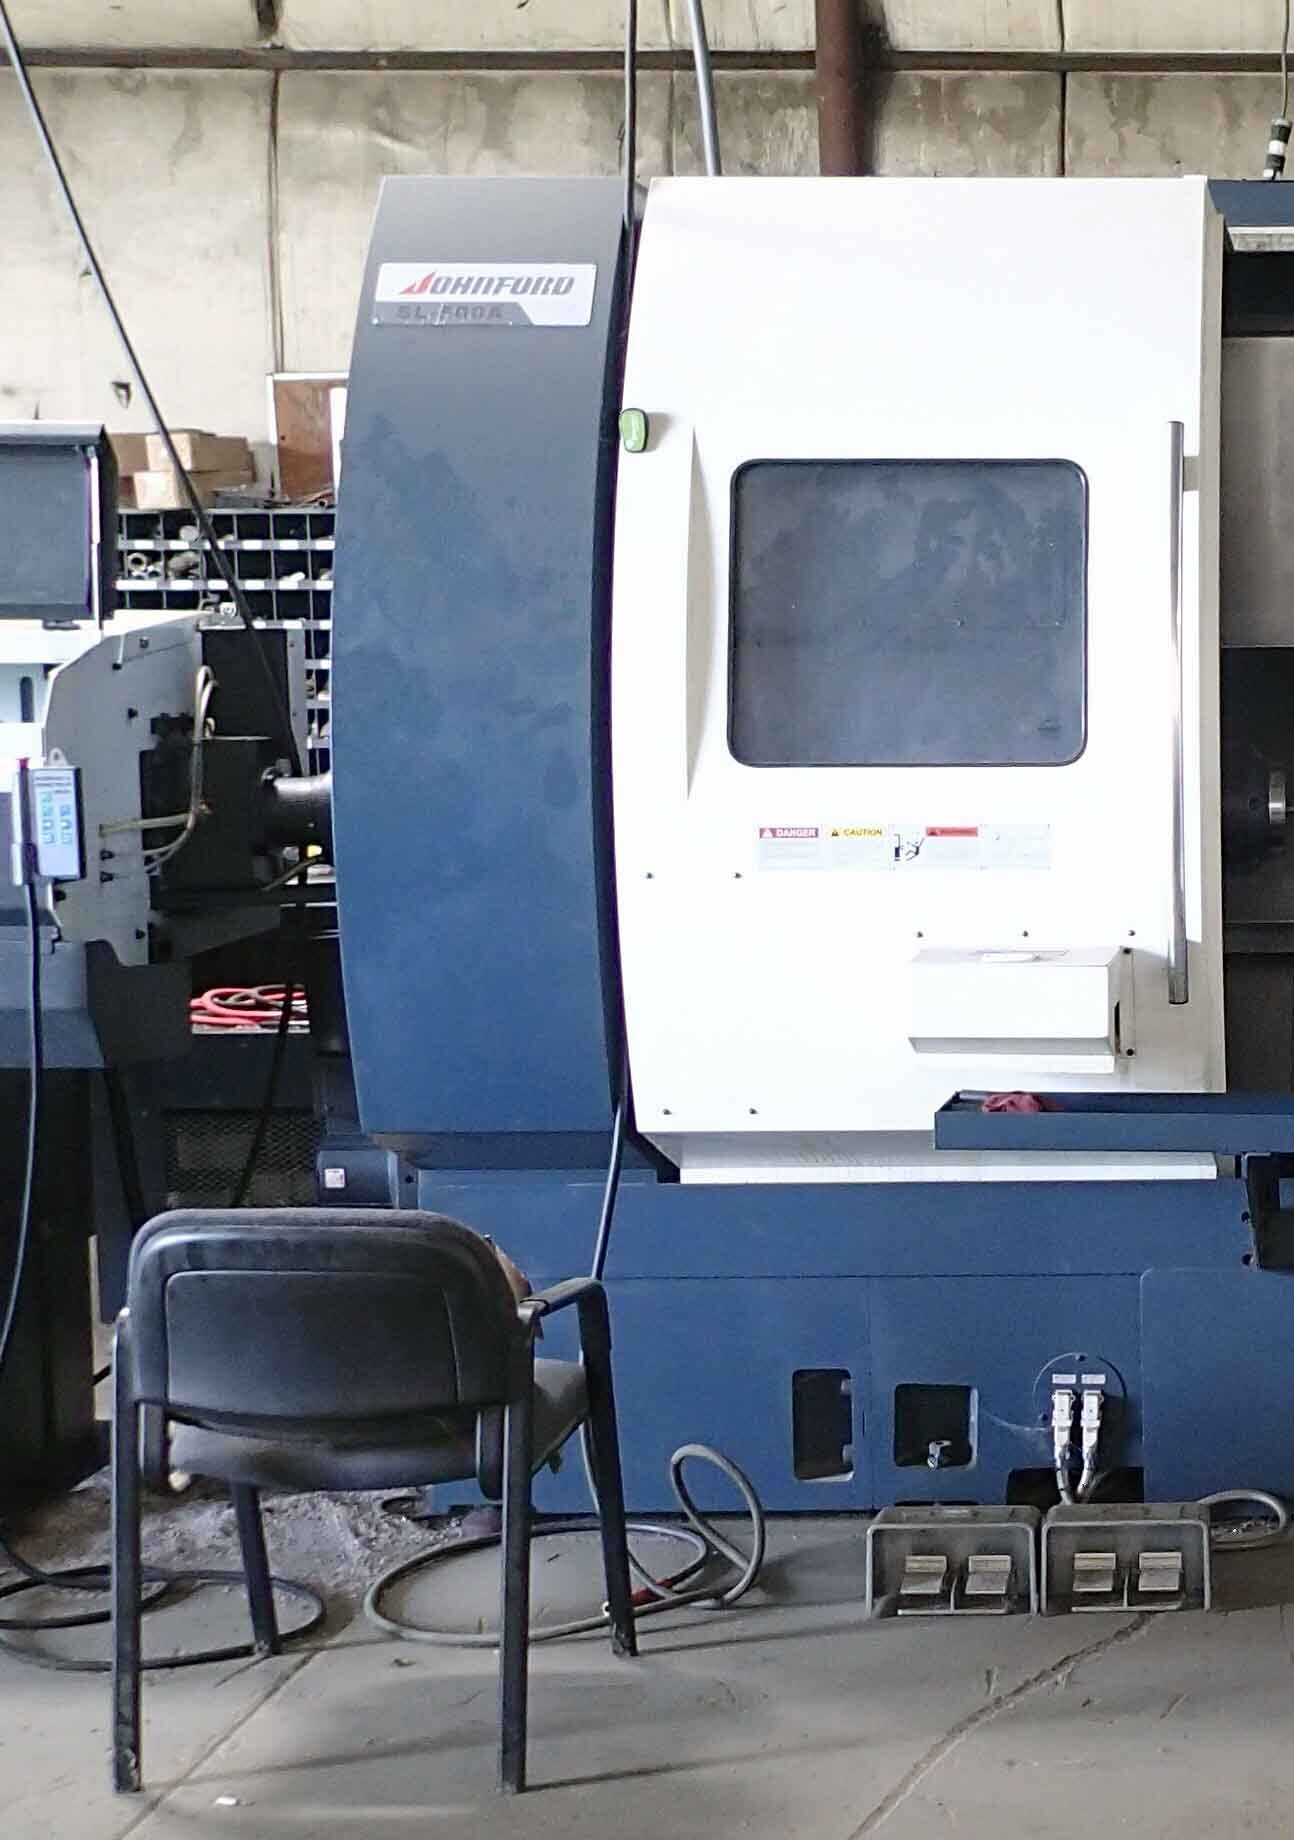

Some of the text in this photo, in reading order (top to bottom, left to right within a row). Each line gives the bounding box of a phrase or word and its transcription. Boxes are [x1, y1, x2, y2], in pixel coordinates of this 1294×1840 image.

[399, 271, 575, 296] JOHNFORD
[775, 827, 817, 838] DANGER
[842, 828, 883, 837] CAUTION
